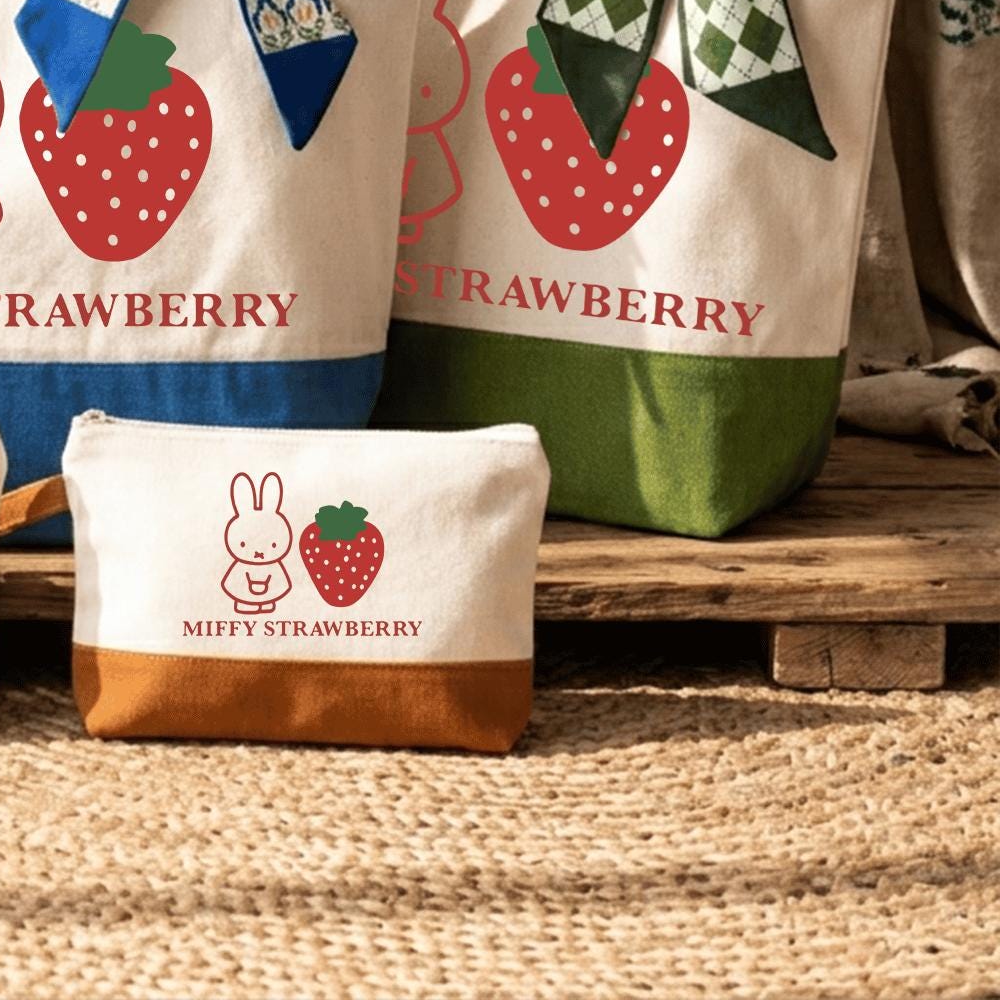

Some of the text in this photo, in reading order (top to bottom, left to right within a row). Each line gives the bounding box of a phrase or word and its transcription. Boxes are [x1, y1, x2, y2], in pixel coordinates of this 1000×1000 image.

[394, 259, 766, 338] STRAWBERRY
[182, 620, 423, 637] MIFFY STRAWBERRY
